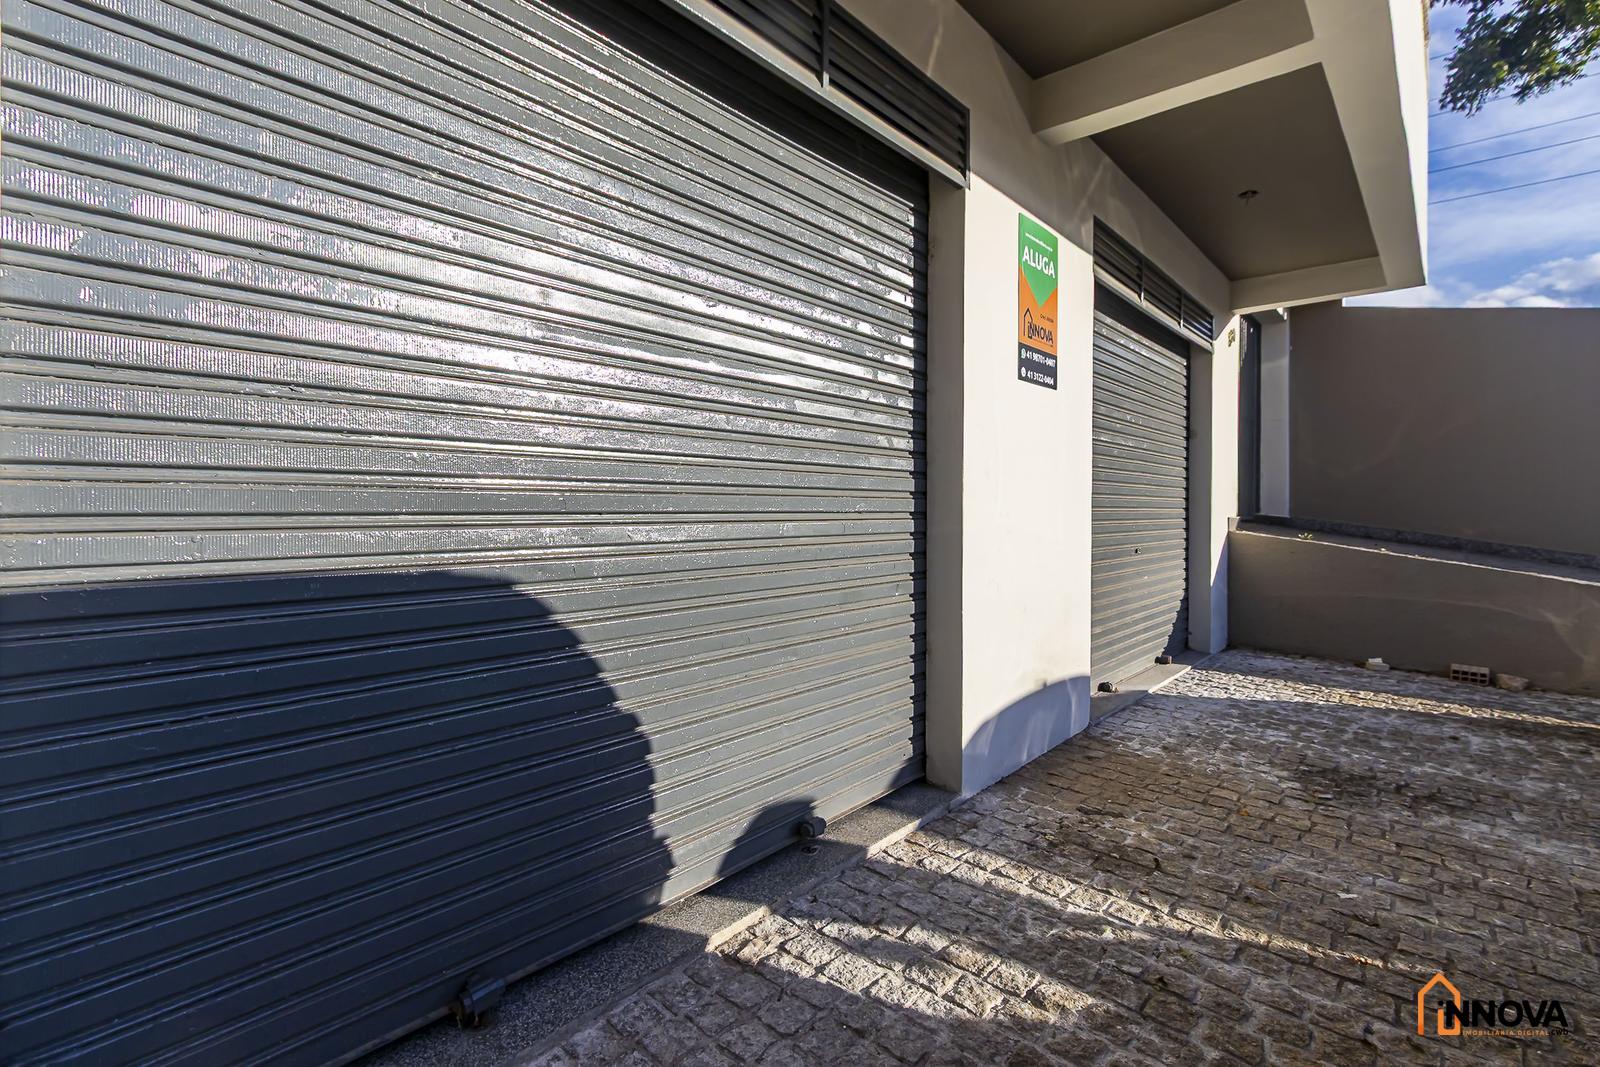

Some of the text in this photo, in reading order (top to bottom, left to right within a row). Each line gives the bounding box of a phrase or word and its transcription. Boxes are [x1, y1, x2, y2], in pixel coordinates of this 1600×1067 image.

[1022, 245, 1055, 279] ALUGA
[1027, 350, 1032, 359] 41
[1027, 370, 1033, 379] 41
